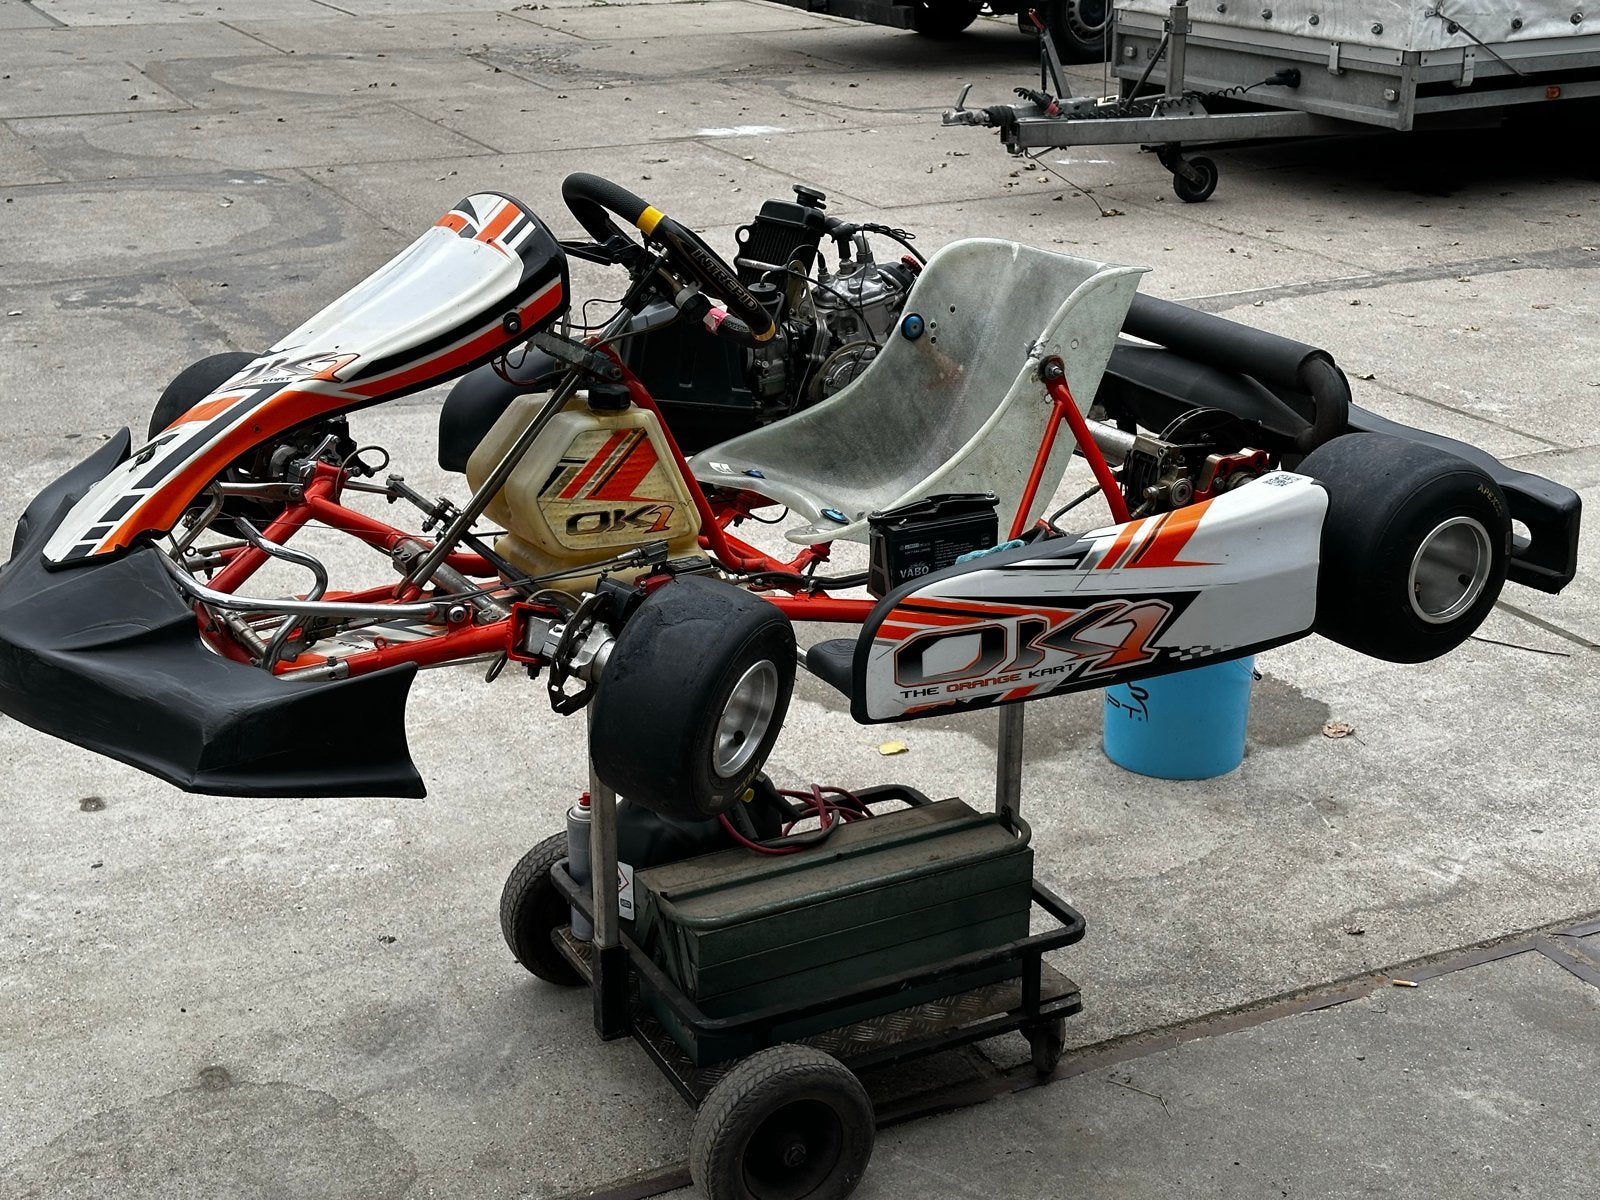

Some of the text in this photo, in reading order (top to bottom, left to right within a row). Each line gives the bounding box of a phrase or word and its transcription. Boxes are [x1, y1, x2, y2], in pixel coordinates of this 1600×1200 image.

[691, 248, 758, 311] INTREPID
[566, 504, 675, 536] OK1
[900, 565, 929, 579] VABO
[894, 601, 1172, 688] OK1
[900, 663, 1076, 699] THE ORANGE KART
